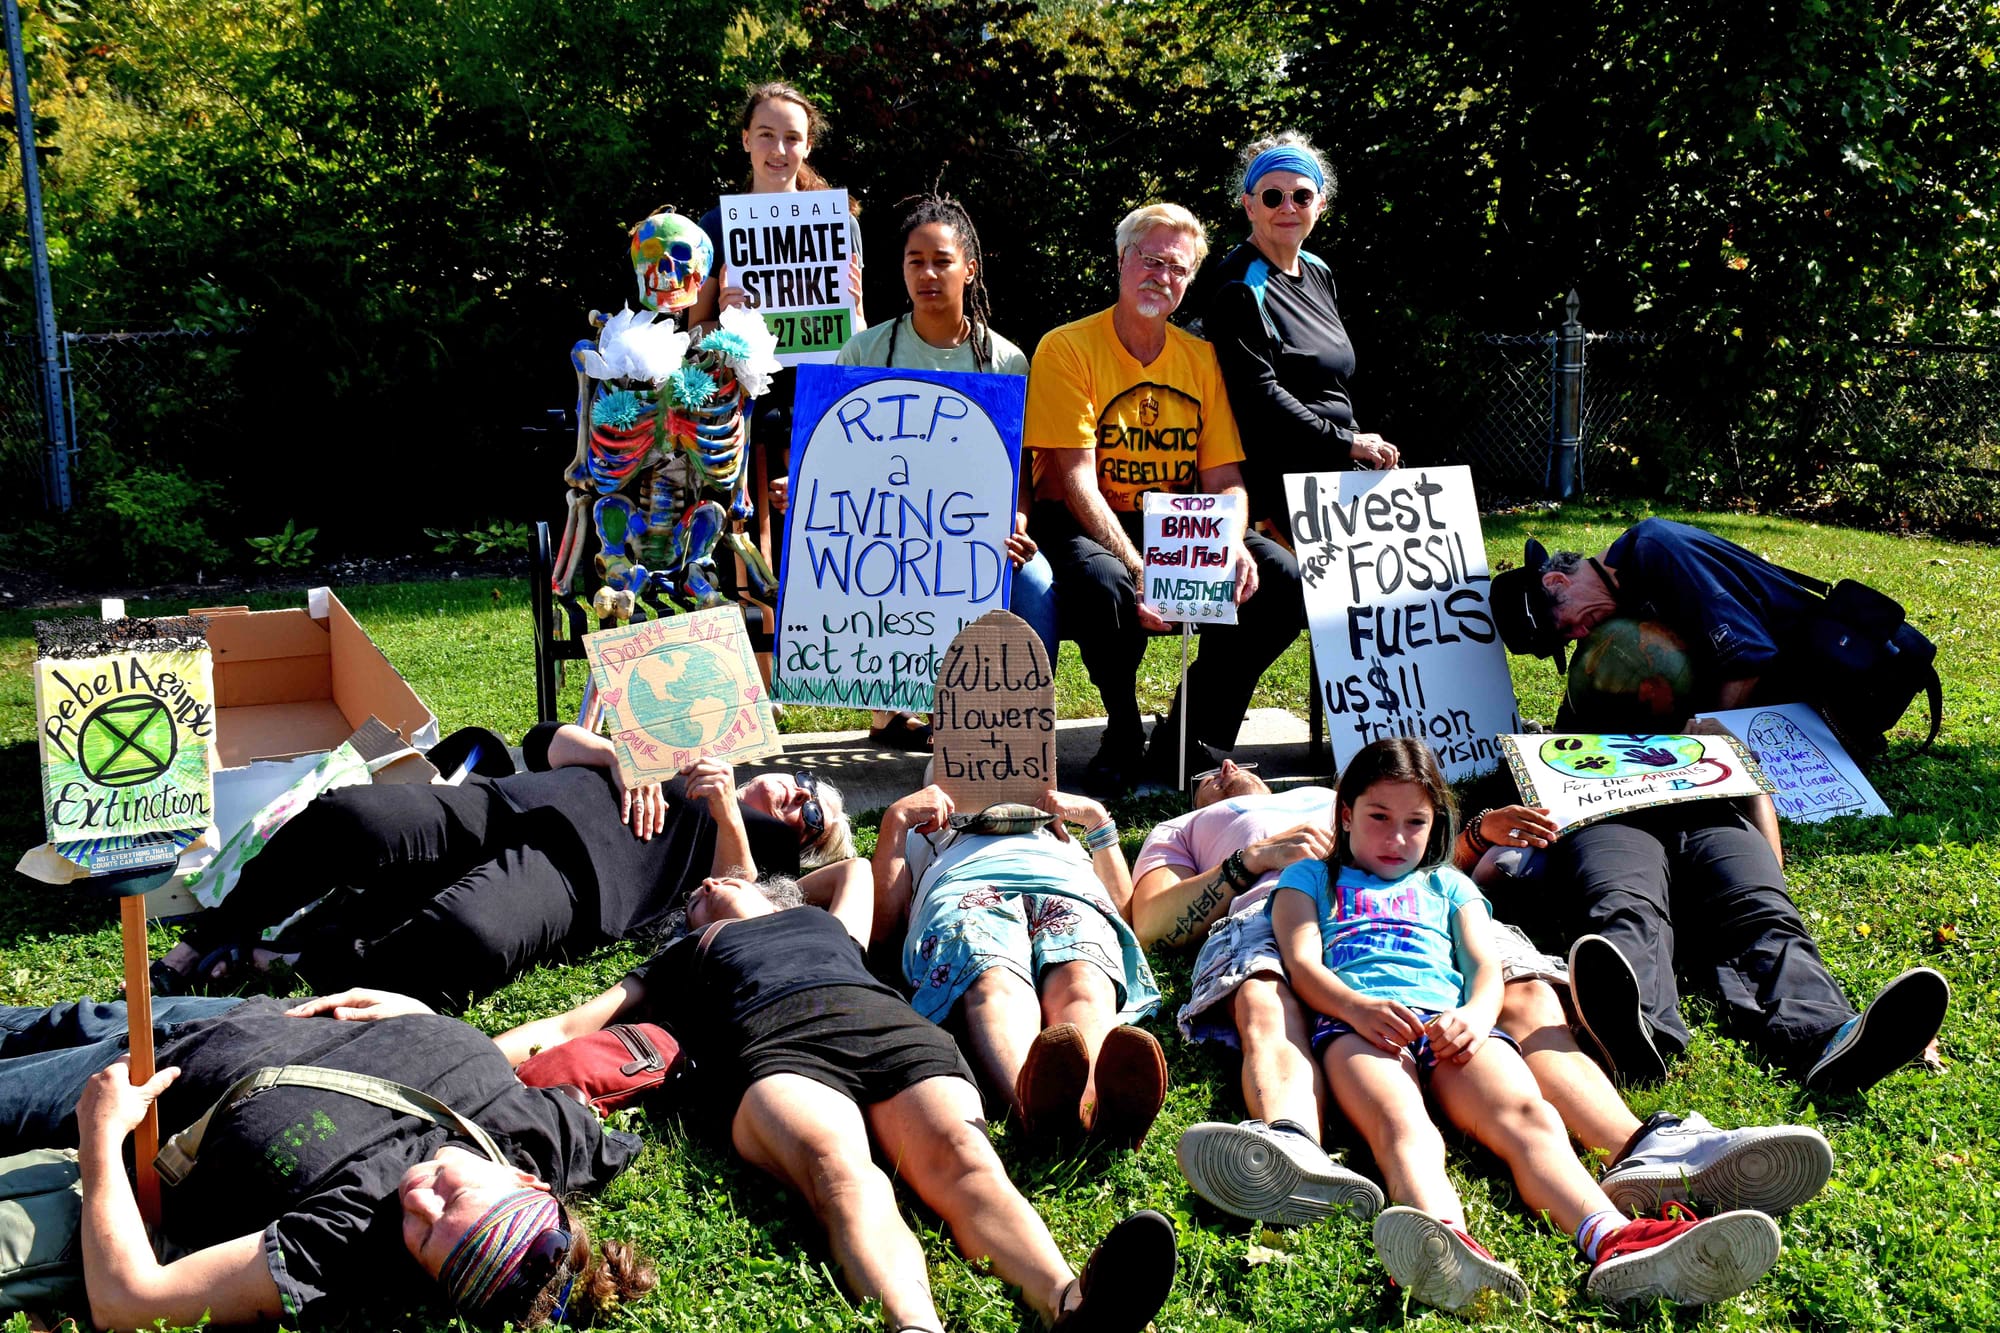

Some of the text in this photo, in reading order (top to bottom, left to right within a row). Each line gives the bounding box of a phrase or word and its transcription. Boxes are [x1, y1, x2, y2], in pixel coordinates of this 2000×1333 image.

[728, 202, 841, 220] GLOBAL
[729, 222, 847, 267] CLIMATE
[741, 266, 840, 309] STRIKE
[800, 314, 844, 346] SEPT
[837, 394, 968, 443] R.I.P.
[888, 455, 909, 486] a
[804, 478, 989, 540] LIVING
[1170, 497, 1216, 512] STOP
[1291, 473, 1446, 544] divest
[1161, 515, 1223, 539] BANK
[805, 535, 1002, 604] WORLD
[1191, 545, 1229, 568] Fuel
[1299, 540, 1344, 589] FROM
[1347, 531, 1491, 603] FOSSIL
[1152, 577, 1235, 602] INVESTMENT
[822, 600, 936, 638] unless
[1347, 589, 1496, 660] FUELS
[786, 636, 842, 675] act
[851, 642, 883, 674] to
[945, 641, 1050, 692] Wild
[45, 661, 123, 761] Rebel
[935, 689, 1055, 731] flowers
[943, 742, 1049, 782] birds!
[1563, 766, 1708, 793] For the Animals
[53, 782, 211, 829] Extinction
[1578, 778, 1697, 807] No Planet B
[1802, 787, 1853, 805] LIVES
[96, 847, 168, 863] NOT EVERYTHING THAT
[120, 857, 133, 865] CAN
[145, 852, 174, 862] COUNTED
